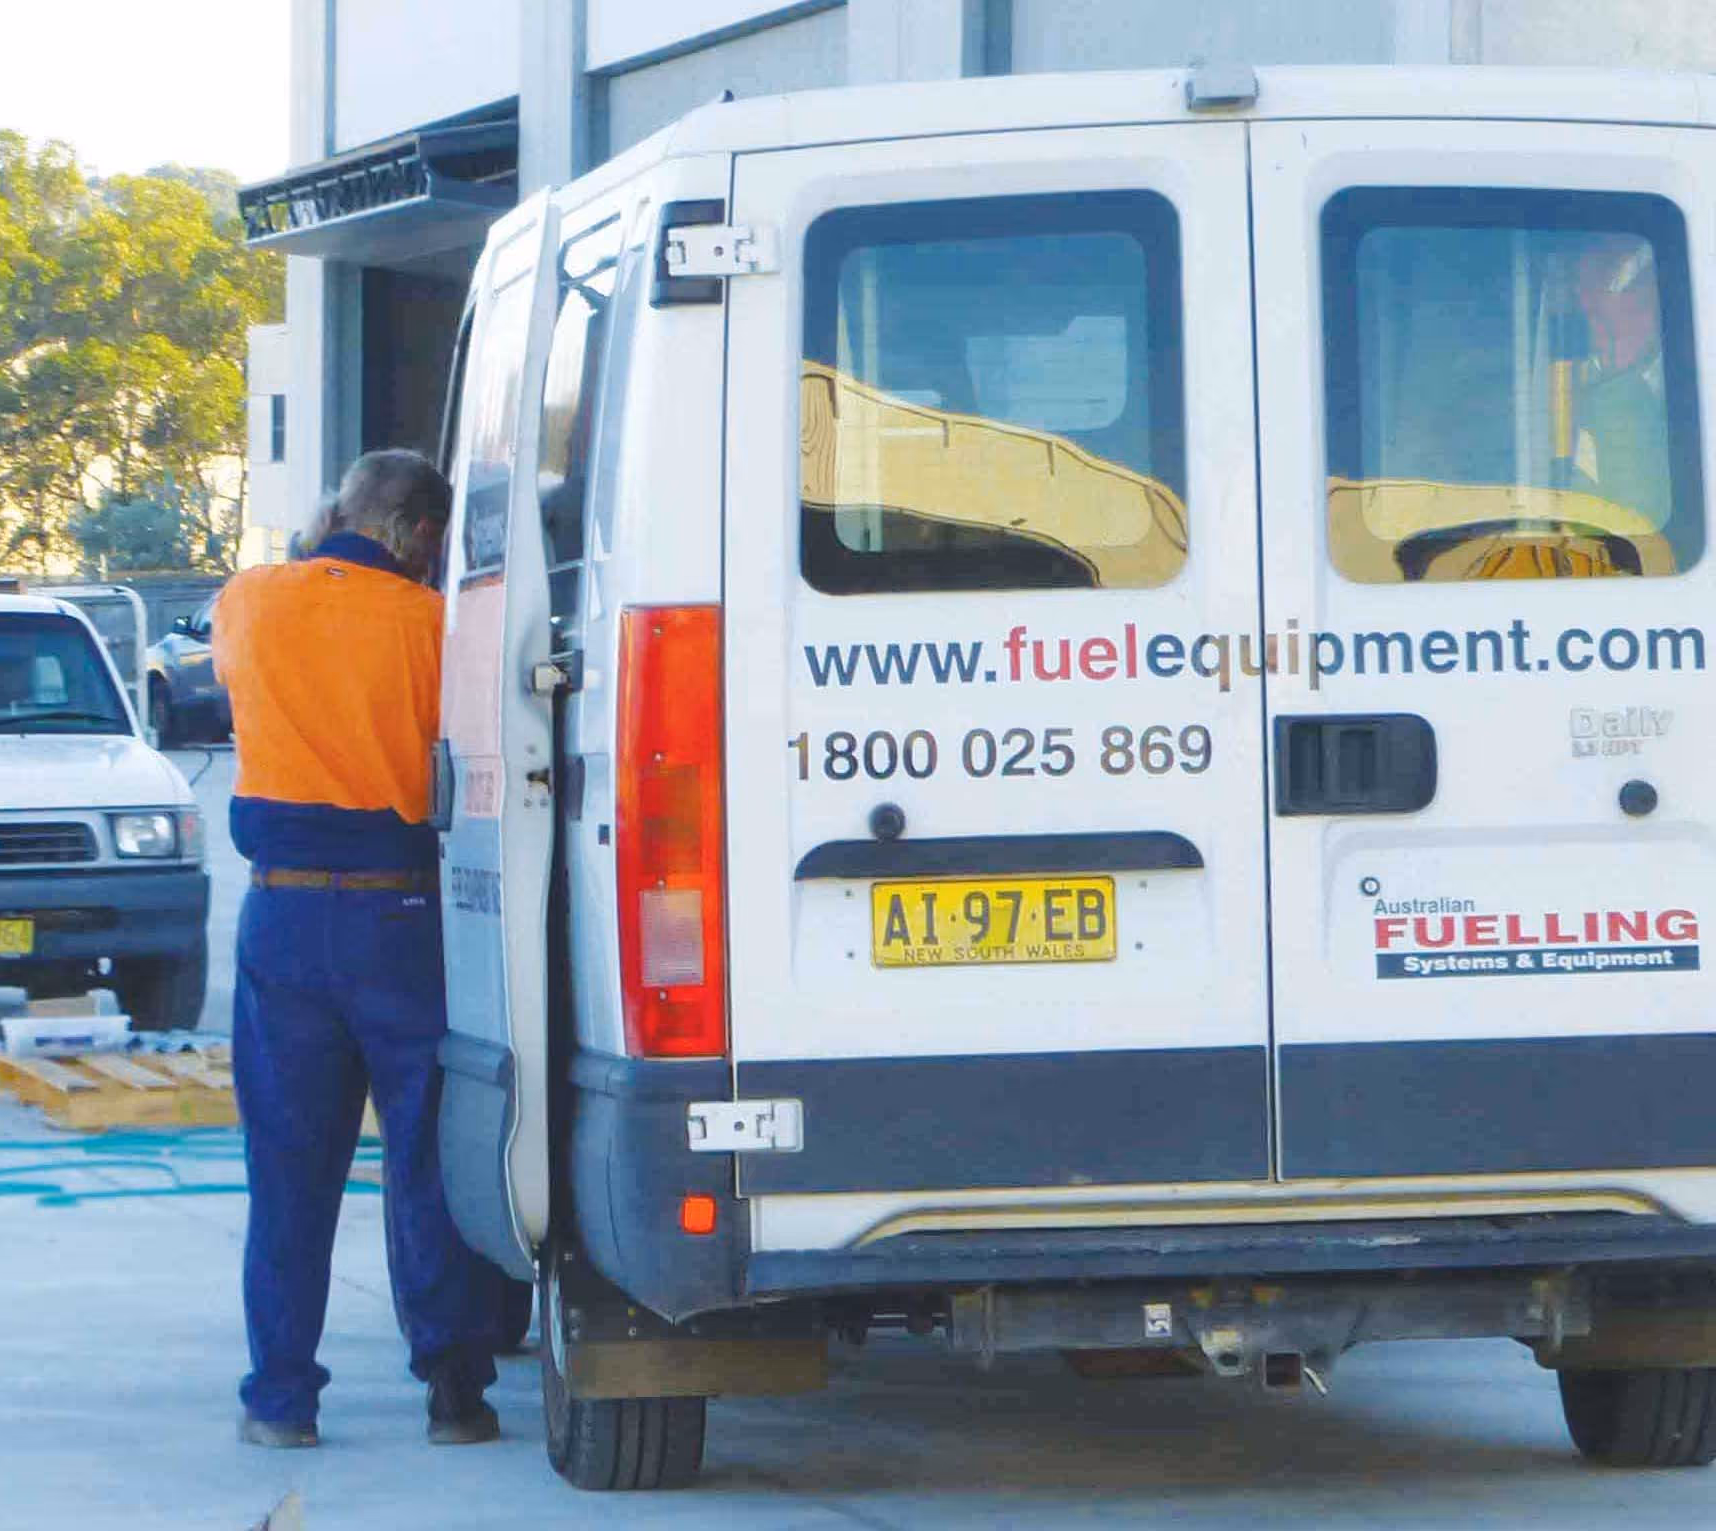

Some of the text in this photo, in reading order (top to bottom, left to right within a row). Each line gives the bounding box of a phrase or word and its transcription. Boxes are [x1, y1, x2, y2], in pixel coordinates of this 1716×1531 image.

[804, 618, 1706, 692] www.fuelequipment.com
[1570, 704, 1675, 738] Daily
[788, 725, 1212, 781] 1800 025 869
[1373, 898, 1475, 915] Australian
[1374, 909, 1699, 949] FUELLING
[904, 945, 1085, 962] NEW SOUTH WALES
[1404, 950, 1674, 974] Systems & Equipment
